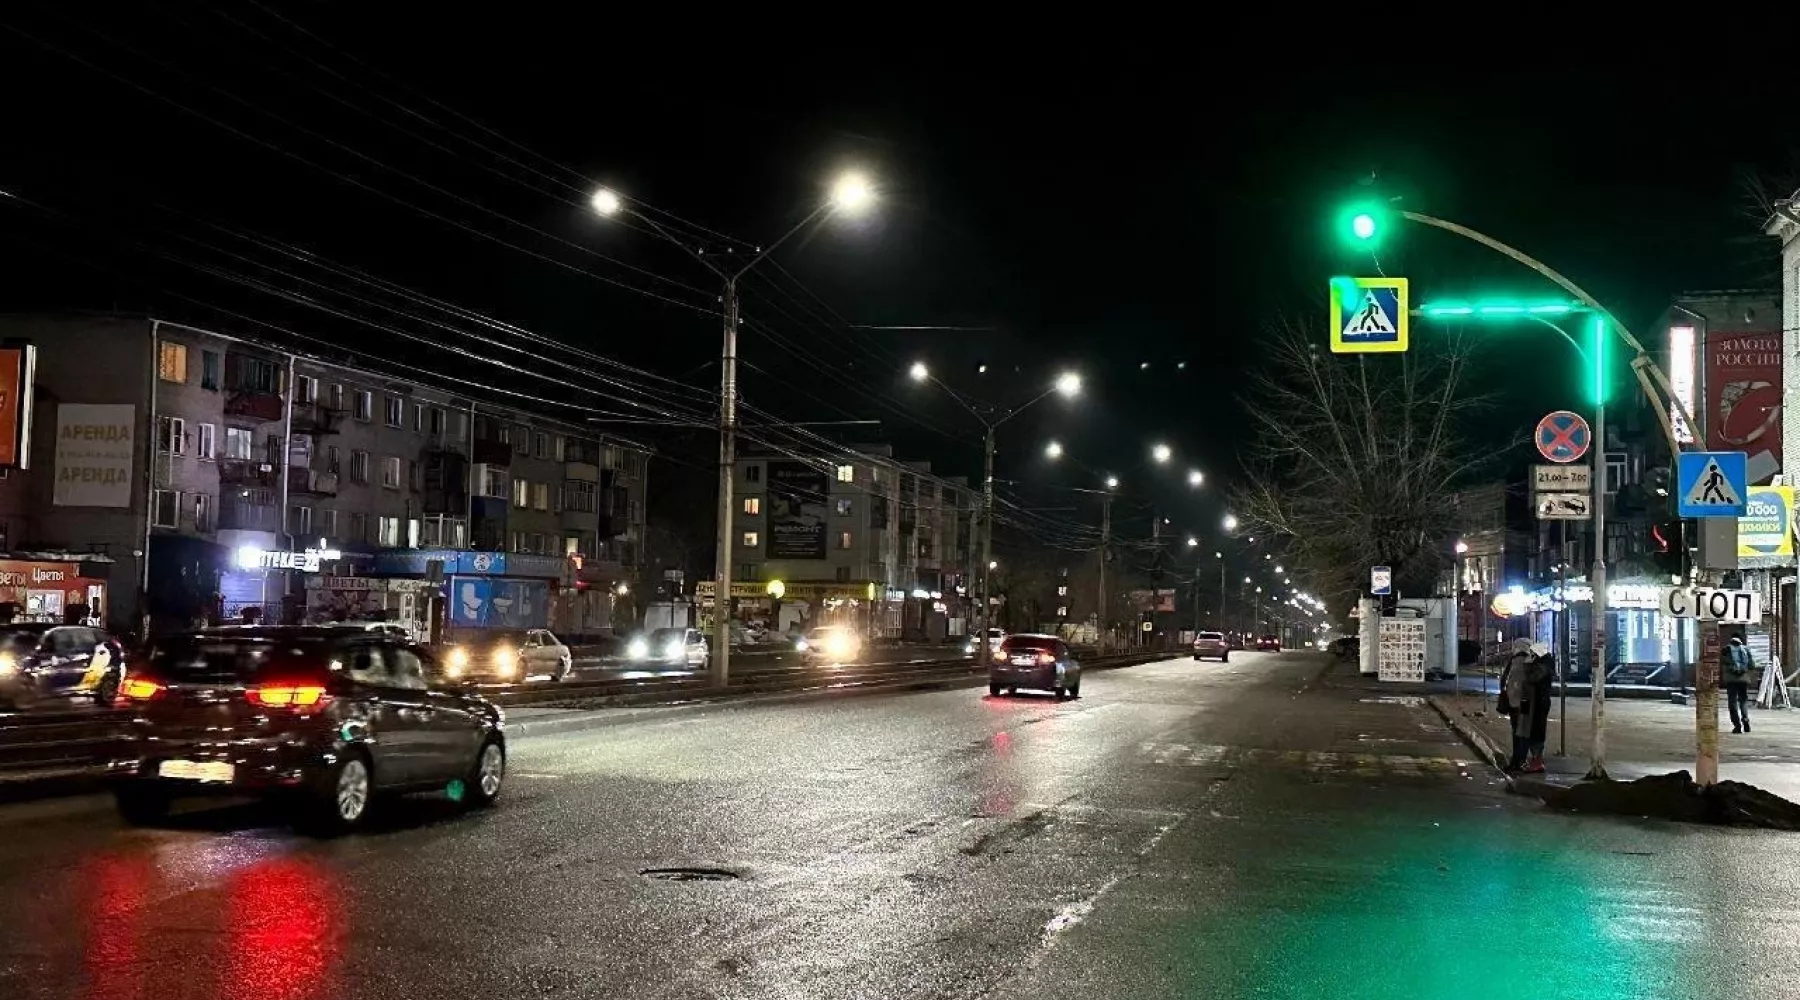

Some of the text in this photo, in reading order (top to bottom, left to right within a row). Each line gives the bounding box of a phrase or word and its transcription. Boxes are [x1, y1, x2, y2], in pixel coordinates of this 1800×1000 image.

[1719, 338, 1779, 351] ЗОЛОТО
[1716, 353, 1780, 366] РОССИИ
[61, 423, 130, 442] АРЕНДА
[59, 466, 128, 486] АРЕНДА
[33, 566, 64, 584] Цветы
